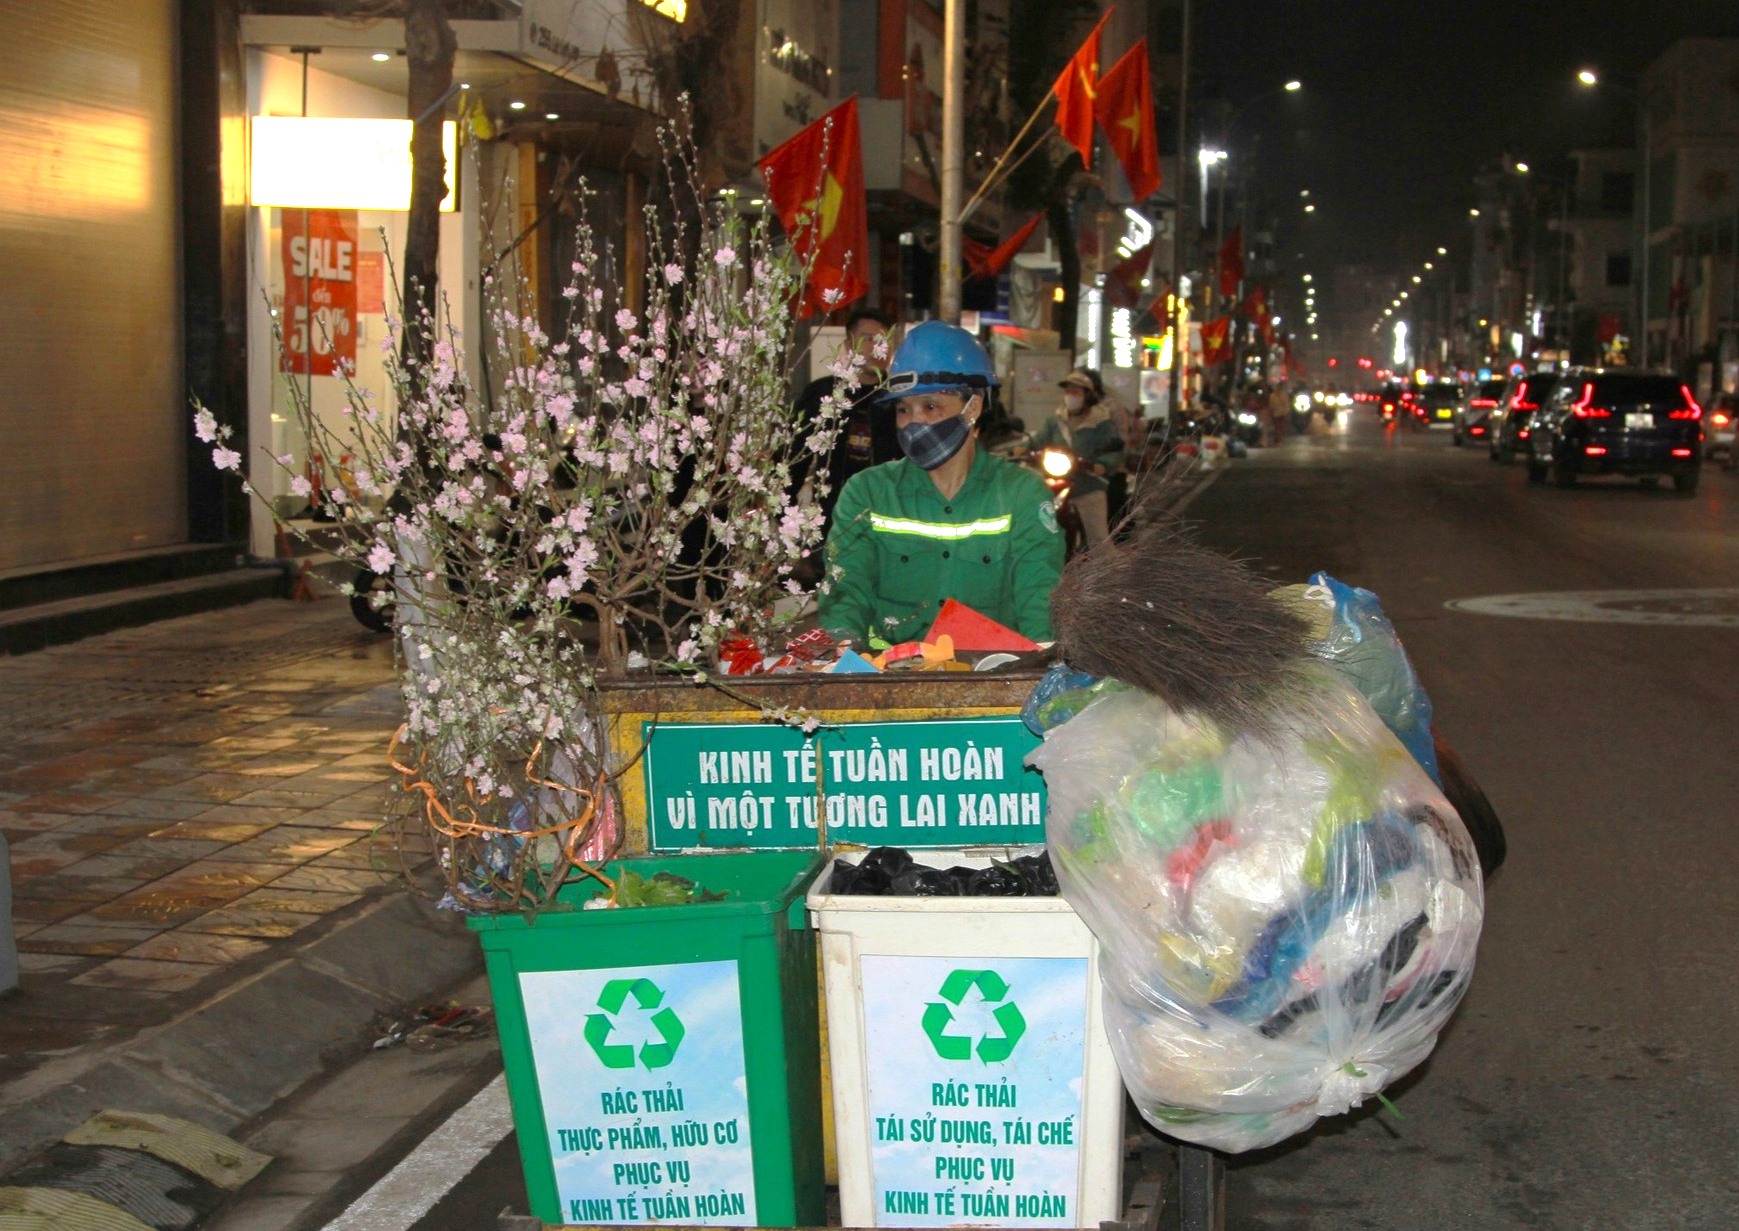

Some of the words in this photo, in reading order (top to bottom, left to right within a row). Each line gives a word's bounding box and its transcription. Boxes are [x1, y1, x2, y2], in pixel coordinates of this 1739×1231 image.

[290, 236, 353, 282] SALE
[290, 305, 350, 355] 50%
[699, 751, 772, 784] KINH
[783, 738, 816, 783] TẾ
[828, 736, 908, 782] TUẦN
[920, 741, 1004, 781] HOÀN
[667, 791, 696, 829] VÌ
[708, 790, 775, 836] MỘT
[785, 792, 888, 829] TƯƠNG
[900, 794, 946, 827] LAI
[958, 792, 1041, 826] XANH
[601, 1087, 638, 1114] RÁC
[642, 1081, 684, 1112] THẢI
[932, 1078, 969, 1107] RÁC
[975, 1077, 1016, 1108] THẢI
[558, 1127, 603, 1156] THỰC
[608, 1118, 667, 1151] PHẨM,
[671, 1120, 709, 1147] HỮU
[714, 1119, 738, 1144] CƠ
[876, 1113, 904, 1142] TÁI
[910, 1112, 936, 1143] SỬ
[941, 1120, 997, 1149] DỤNG,
[1003, 1117, 1031, 1145] TÁI
[1038, 1114, 1075, 1145] CHẾ
[613, 1162, 662, 1189] PHỤC
[666, 1160, 691, 1187] VỤ
[935, 1156, 985, 1185] PHỤC
[991, 1157, 1015, 1186] VỤ
[570, 1199, 613, 1221] KINH
[617, 1191, 639, 1220] TẾ
[642, 1189, 690, 1219] TUẦN
[695, 1189, 745, 1217] HOÀN
[885, 1190, 929, 1215] KINH
[934, 1186, 956, 1216] TẾ
[961, 1186, 1010, 1217] TUẦN
[1015, 1190, 1066, 1218] HOÀN
